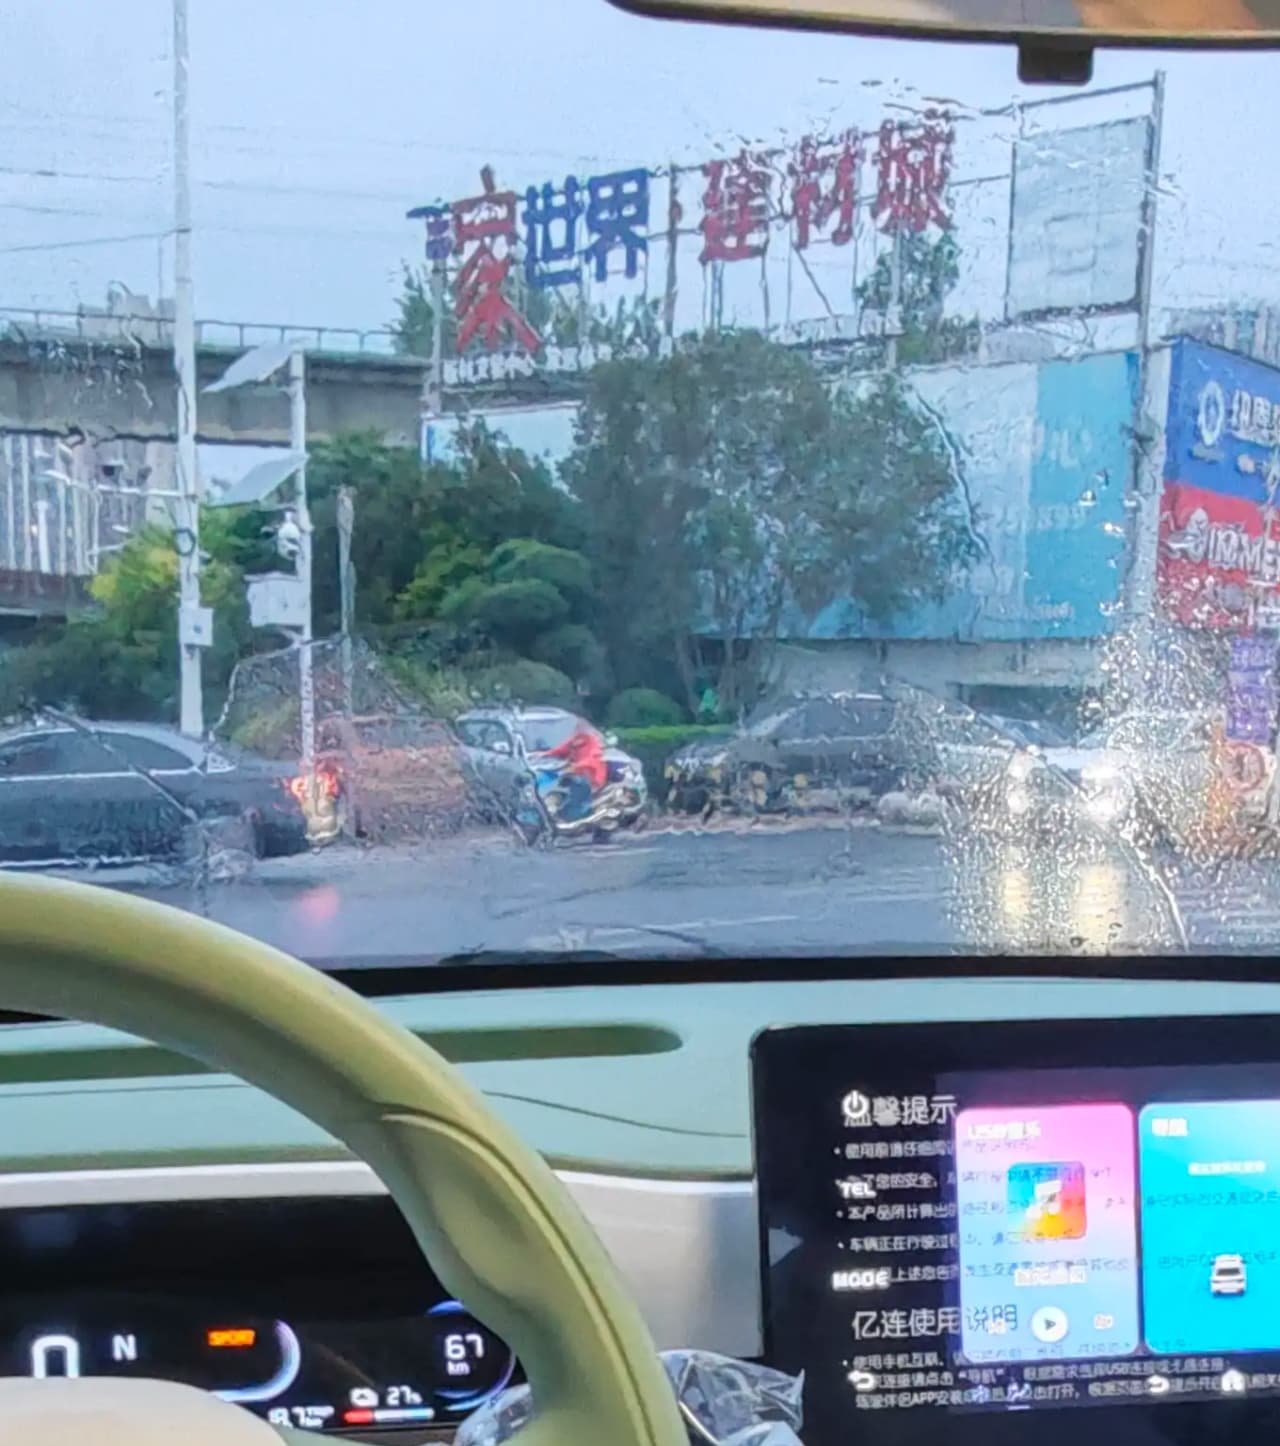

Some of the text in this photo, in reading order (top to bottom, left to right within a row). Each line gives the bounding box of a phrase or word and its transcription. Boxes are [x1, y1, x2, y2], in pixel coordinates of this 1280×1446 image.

[839, 1181, 878, 1199] TEL
[832, 1270, 891, 1291] MODE
[112, 1334, 138, 1362] N
[207, 1328, 257, 1348] SPORT
[444, 1334, 484, 1361] 67
[447, 1361, 471, 1377] km
